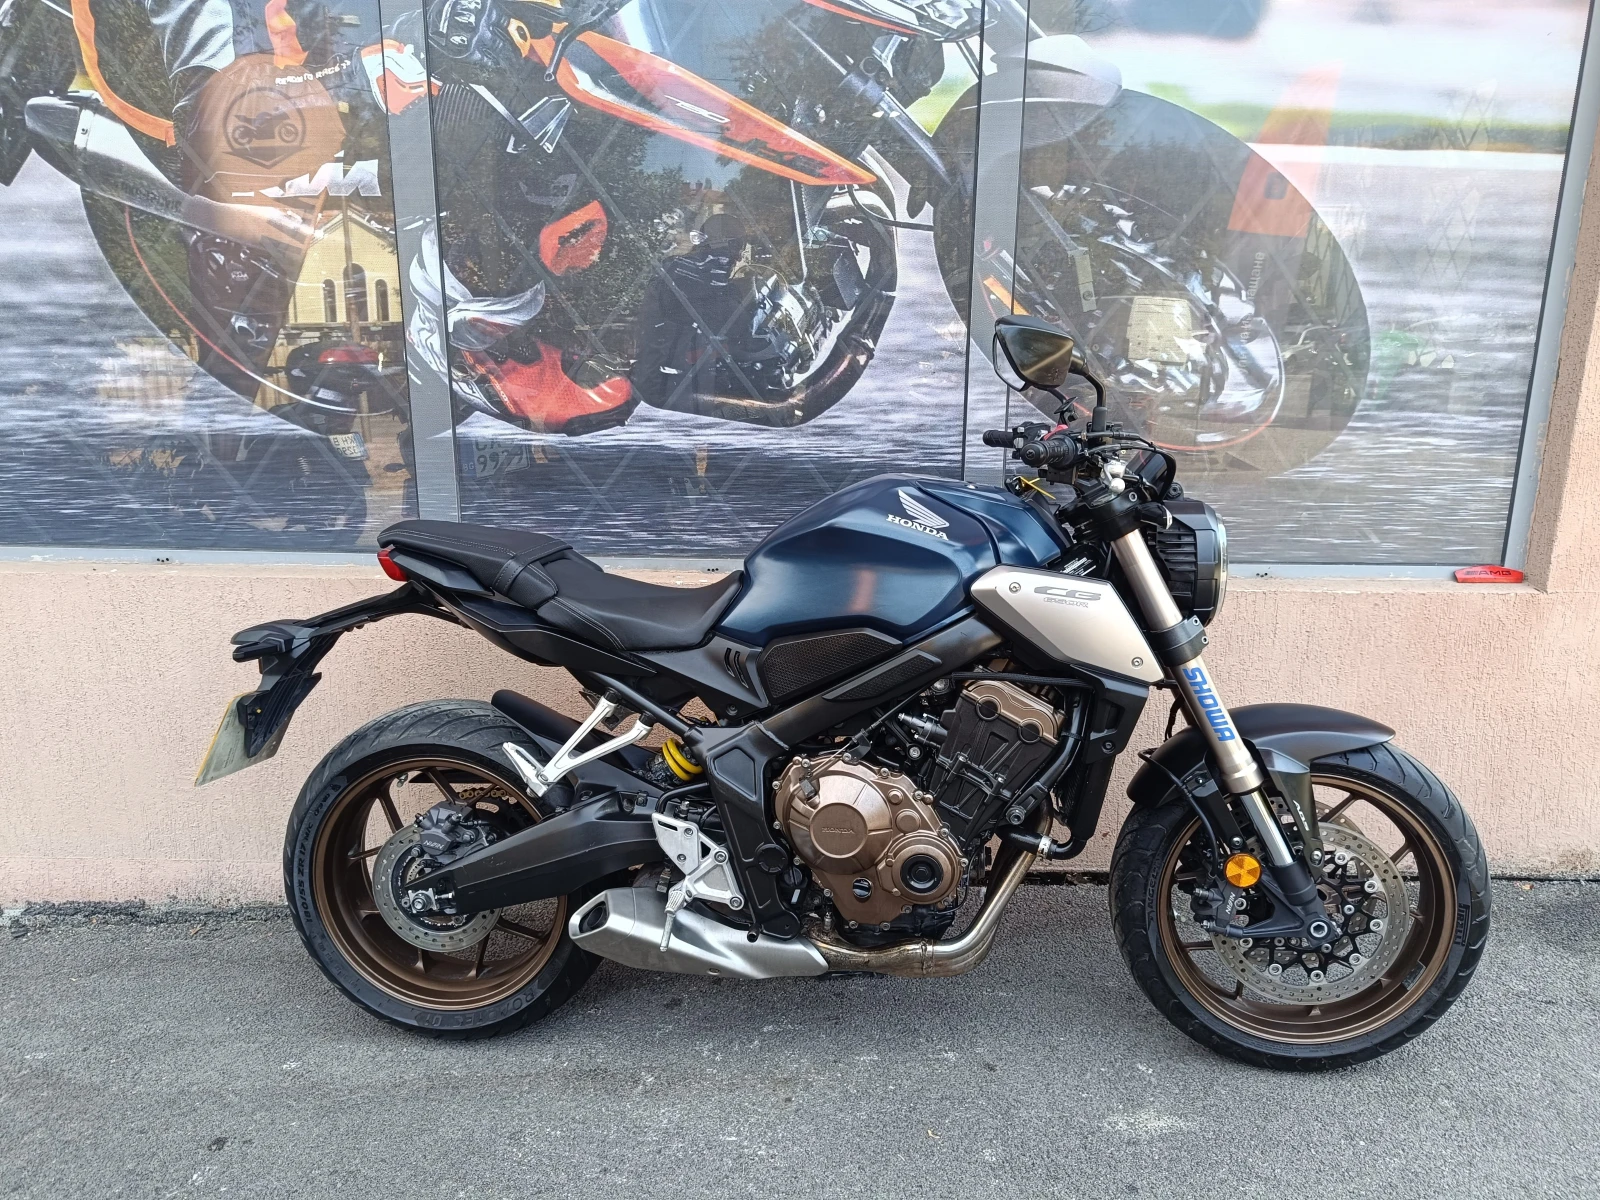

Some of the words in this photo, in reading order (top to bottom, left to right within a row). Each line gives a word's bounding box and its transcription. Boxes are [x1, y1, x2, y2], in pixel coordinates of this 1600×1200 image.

[886, 514, 949, 541] HONDA
[1033, 586, 1102, 601] CB
[1182, 666, 1236, 742] SHOWA
[297, 858, 305, 877] ZR
[297, 878, 314, 924] 180/55
[1454, 902, 1471, 947] PIRELLI
